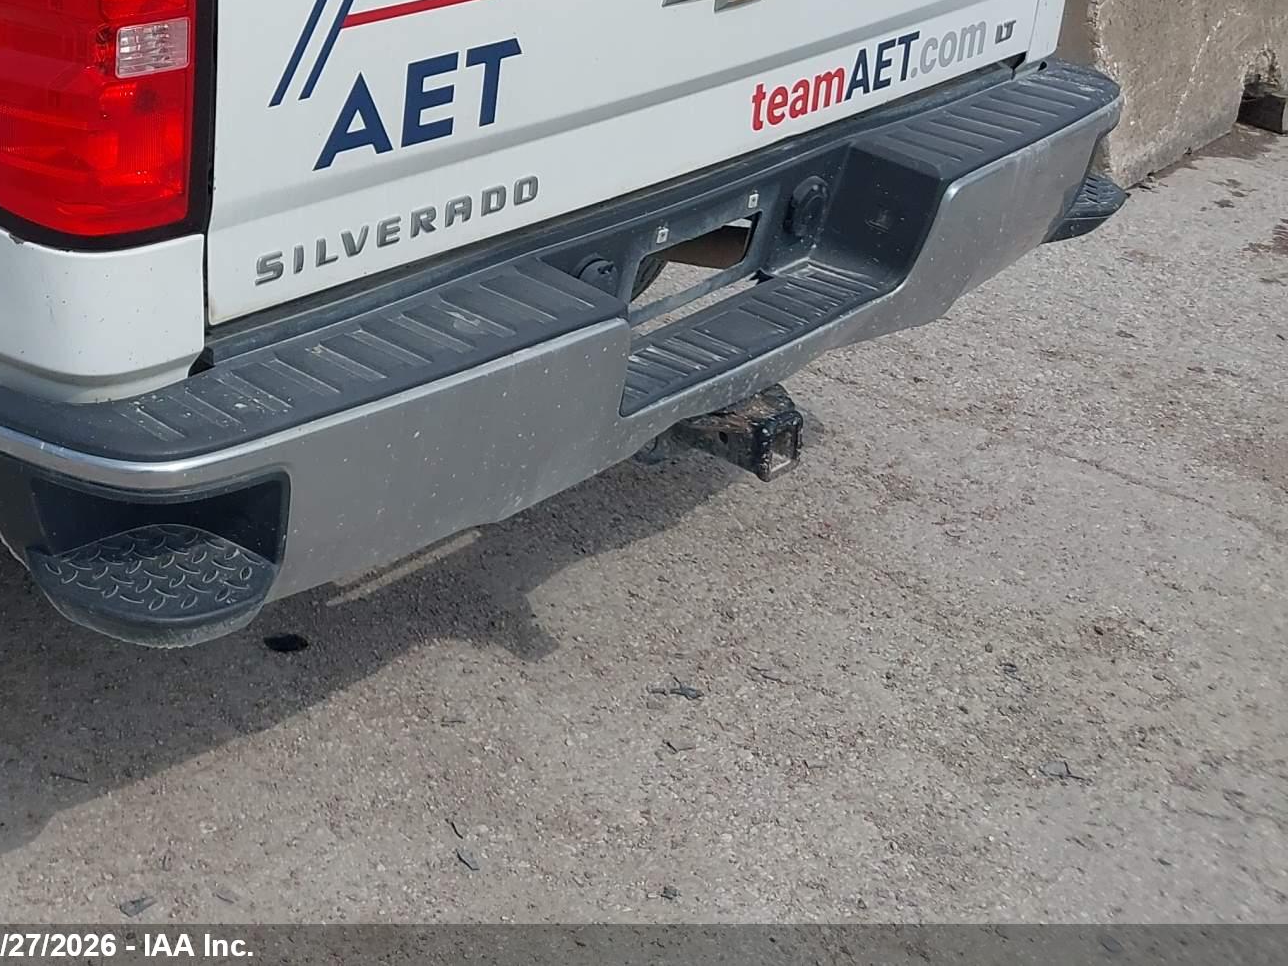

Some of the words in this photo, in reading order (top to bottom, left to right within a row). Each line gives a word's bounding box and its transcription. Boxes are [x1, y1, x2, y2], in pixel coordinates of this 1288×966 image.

[751, 19, 987, 132] teamAET.com
[994, 19, 1017, 45] LT
[312, 36, 523, 172] AET
[254, 174, 540, 286] SILVERADO
